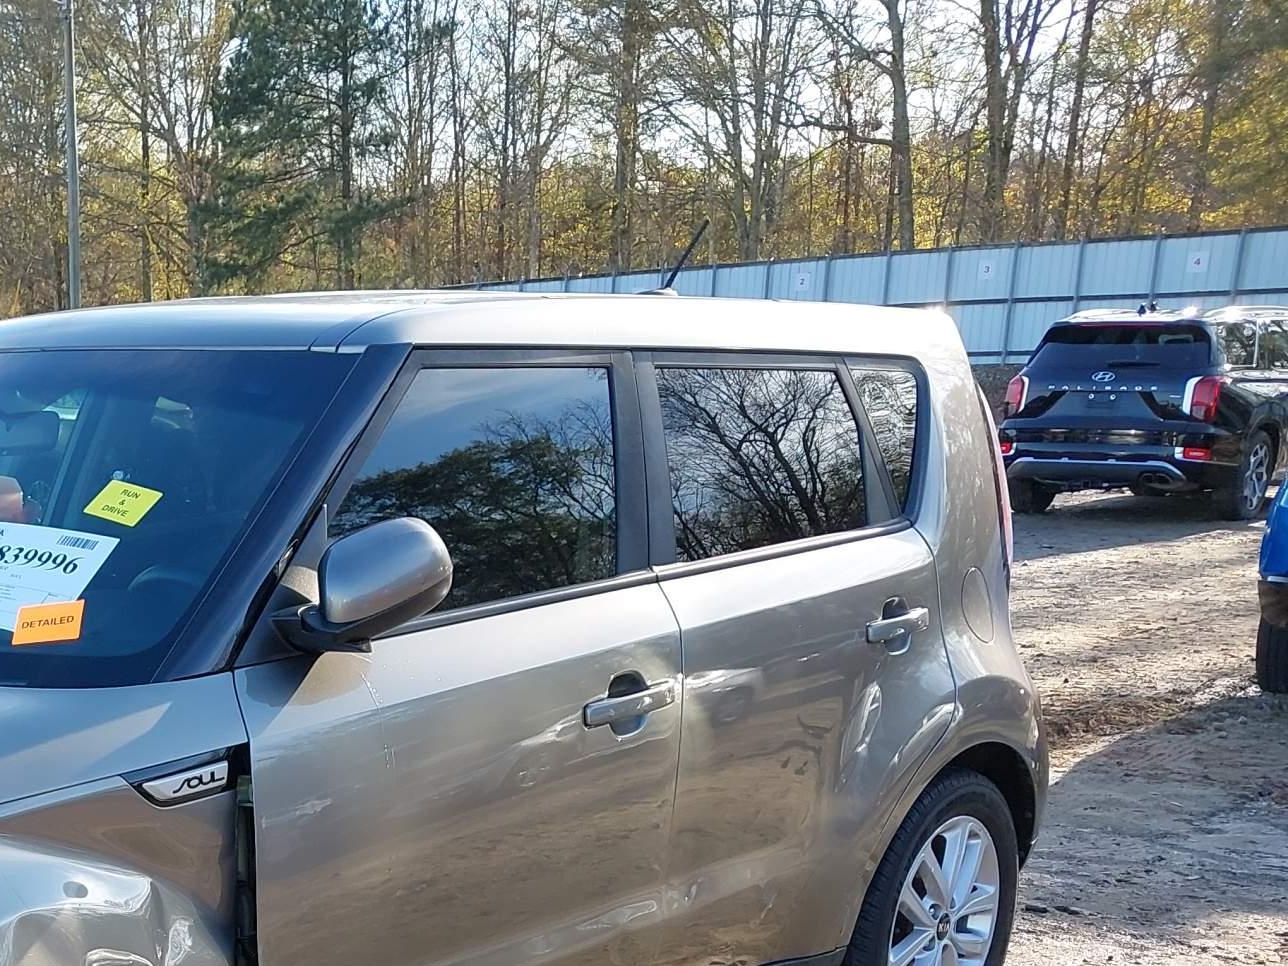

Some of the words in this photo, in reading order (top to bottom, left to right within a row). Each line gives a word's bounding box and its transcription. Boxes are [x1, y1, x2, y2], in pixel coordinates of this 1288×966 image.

[120, 489, 141, 499] RUN
[101, 504, 129, 517] DRIVE
[21, 615, 75, 629] DETAILED
[172, 771, 225, 794] SOUL
